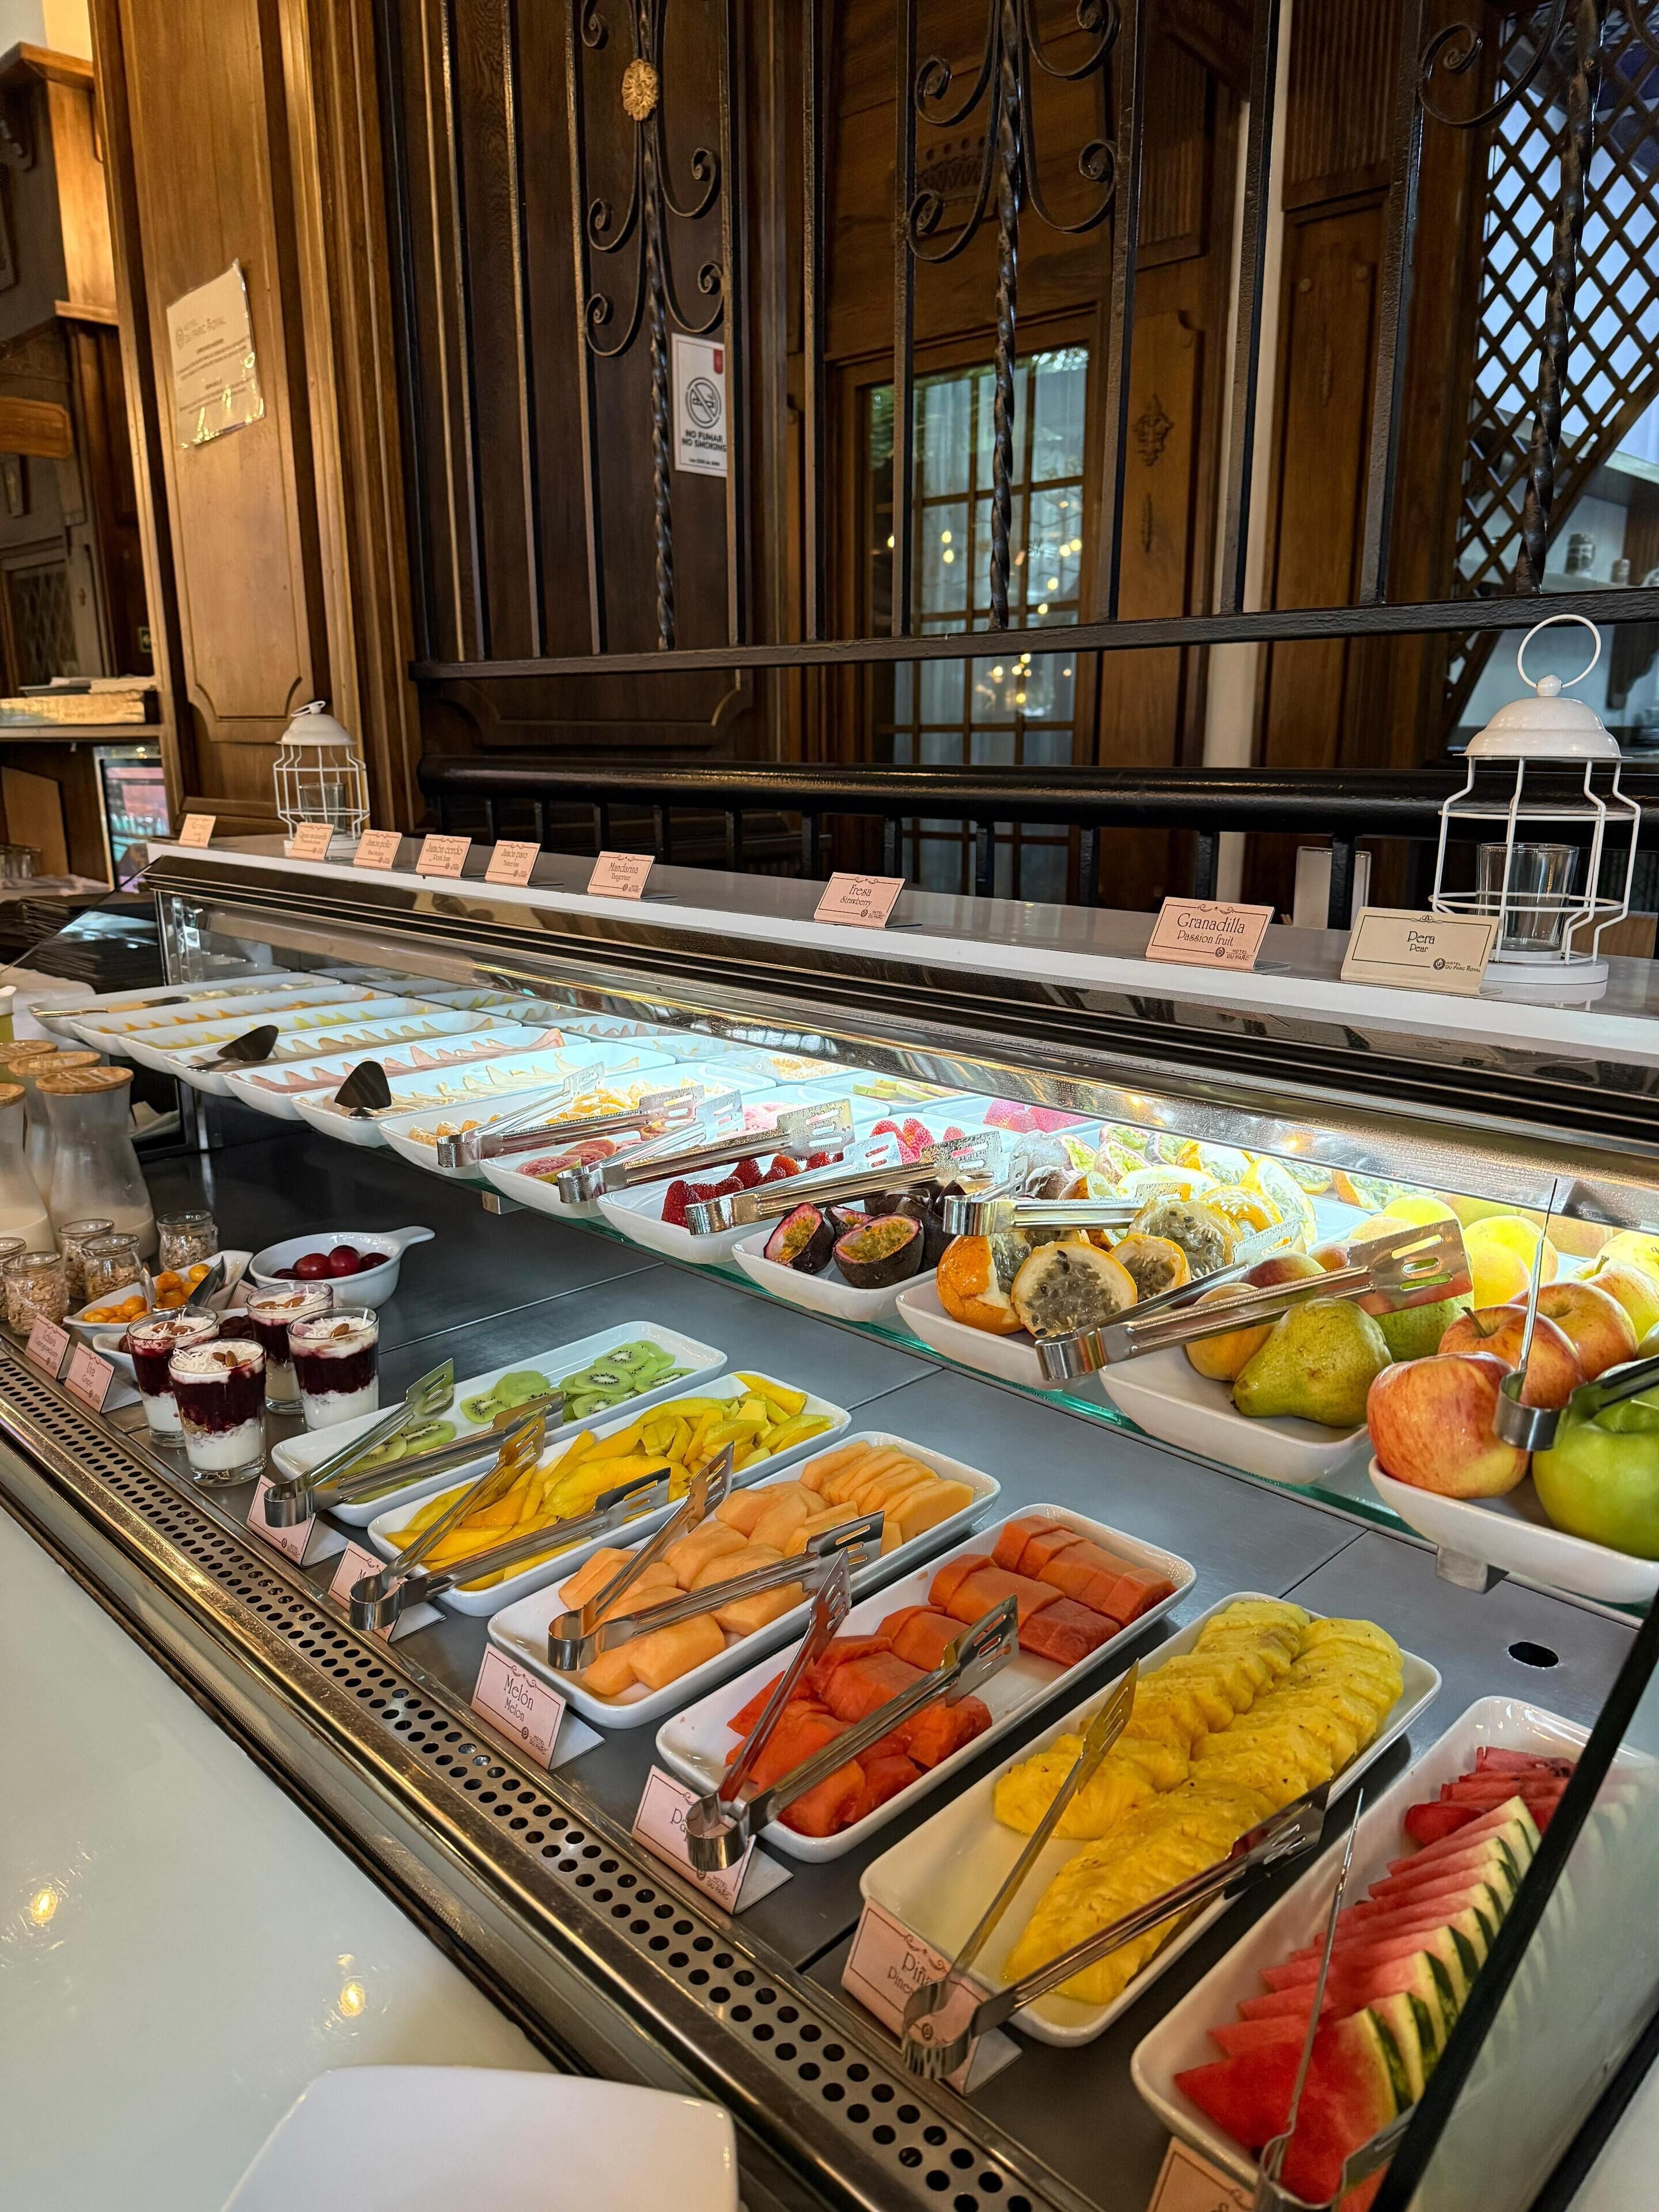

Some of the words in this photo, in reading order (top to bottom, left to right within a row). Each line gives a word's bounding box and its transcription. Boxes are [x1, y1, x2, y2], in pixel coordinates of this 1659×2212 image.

[685, 429, 696, 438] NO
[698, 431, 724, 443] FUMAR
[681, 437, 693, 446] NO
[694, 440, 727, 453] SMOKING
[608, 862, 639, 874] Mandarina
[849, 884, 872, 896] Fresa
[840, 895, 873, 908] Strawberry
[1177, 912, 1245, 934] Granadilla
[1177, 930, 1214, 944] Passion
[1215, 934, 1234, 946] fruit
[1407, 931, 1435, 944] Pera
[1409, 944, 1429, 952] Pear
[503, 1674, 534, 1711] Melón
[504, 1697, 525, 1722] Melon
[707, 1880, 715, 1889] DU
[715, 1886, 729, 1900] PARC
[713, 1875, 728, 1890] HOTEL
